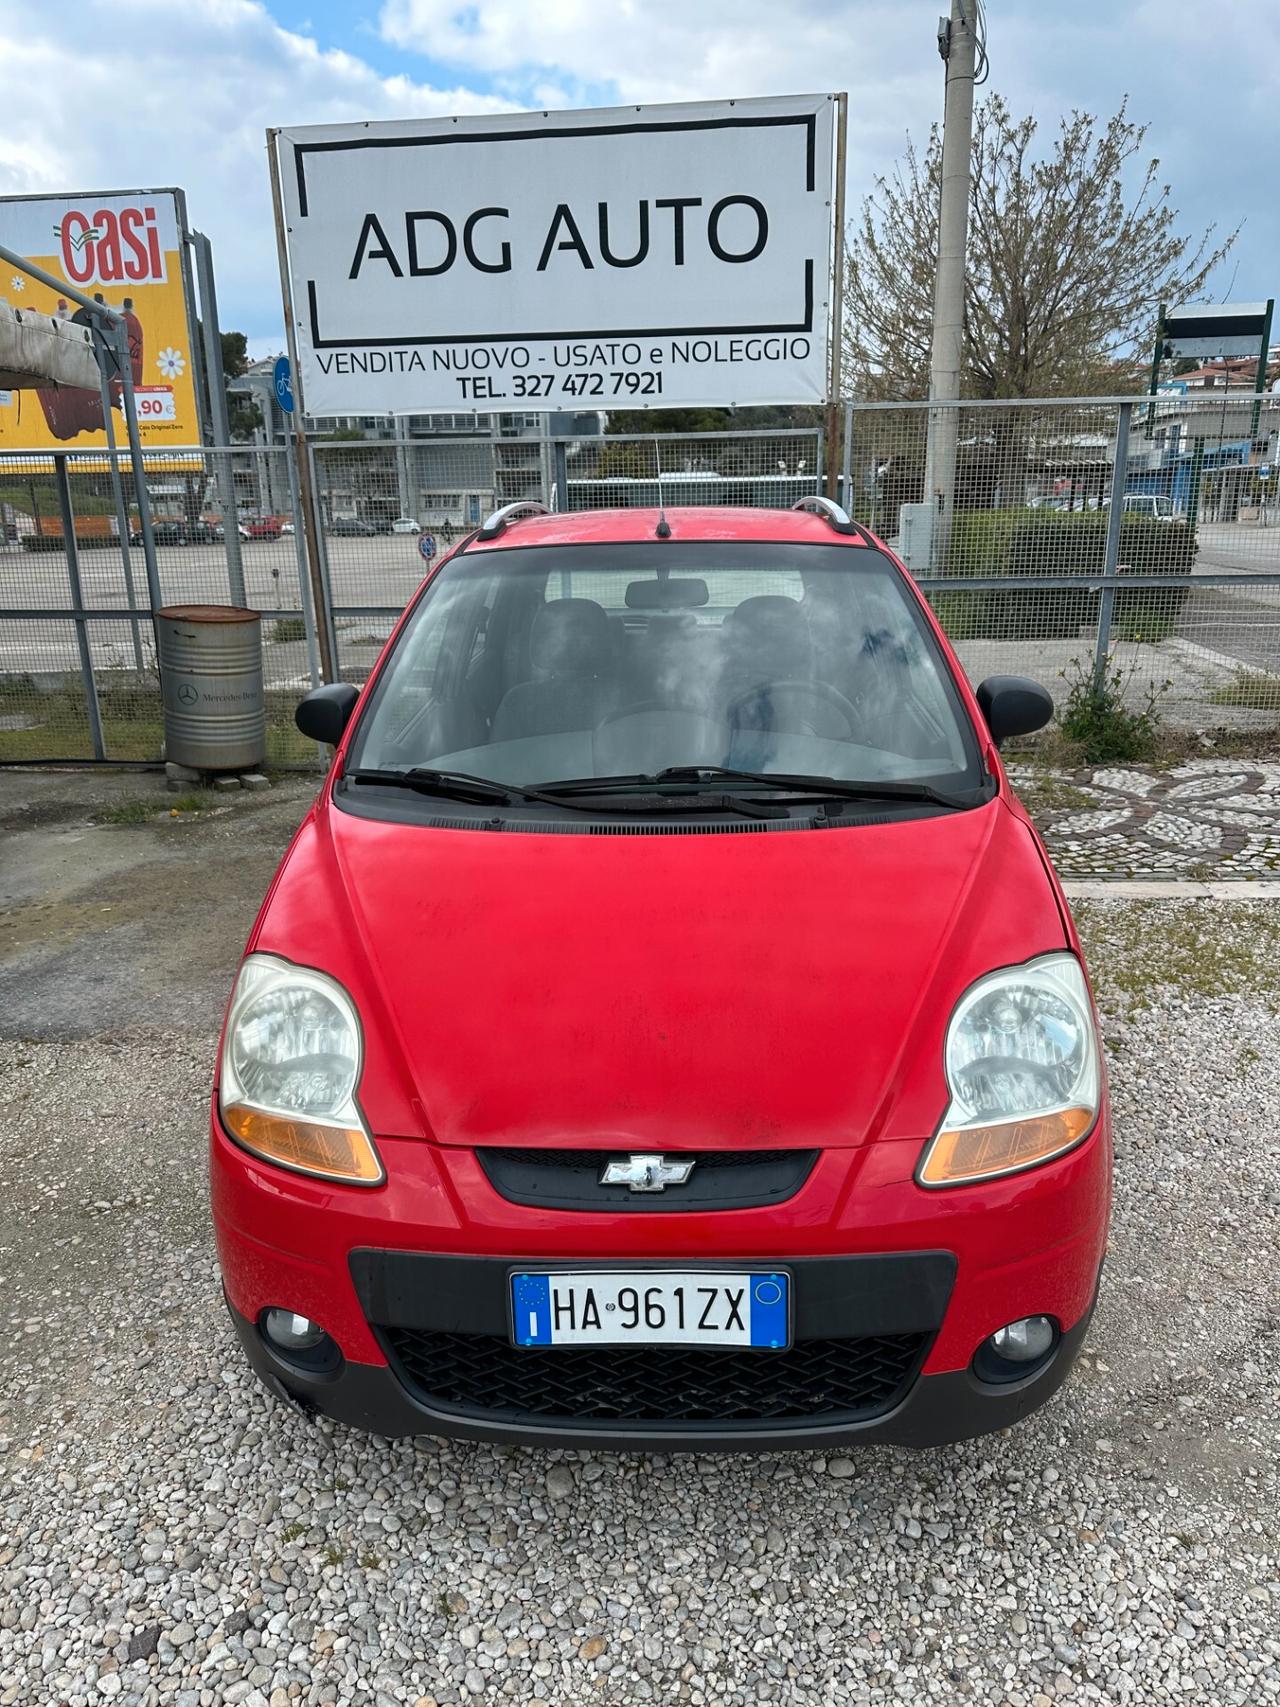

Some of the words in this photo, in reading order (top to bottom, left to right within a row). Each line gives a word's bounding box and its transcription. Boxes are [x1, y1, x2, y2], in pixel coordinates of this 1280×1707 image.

[349, 206, 512, 280] ADG
[536, 194, 769, 271] AUTO
[315, 350, 426, 375] VENDITA
[433, 346, 531, 369] NUOVO
[553, 343, 641, 367] USATO
[649, 348, 664, 365] e
[671, 337, 811, 364] NOLEGGIO
[455, 375, 506, 399] TEL.
[512, 374, 555, 397] 327
[561, 372, 604, 396] 472
[610, 370, 663, 395] 7921
